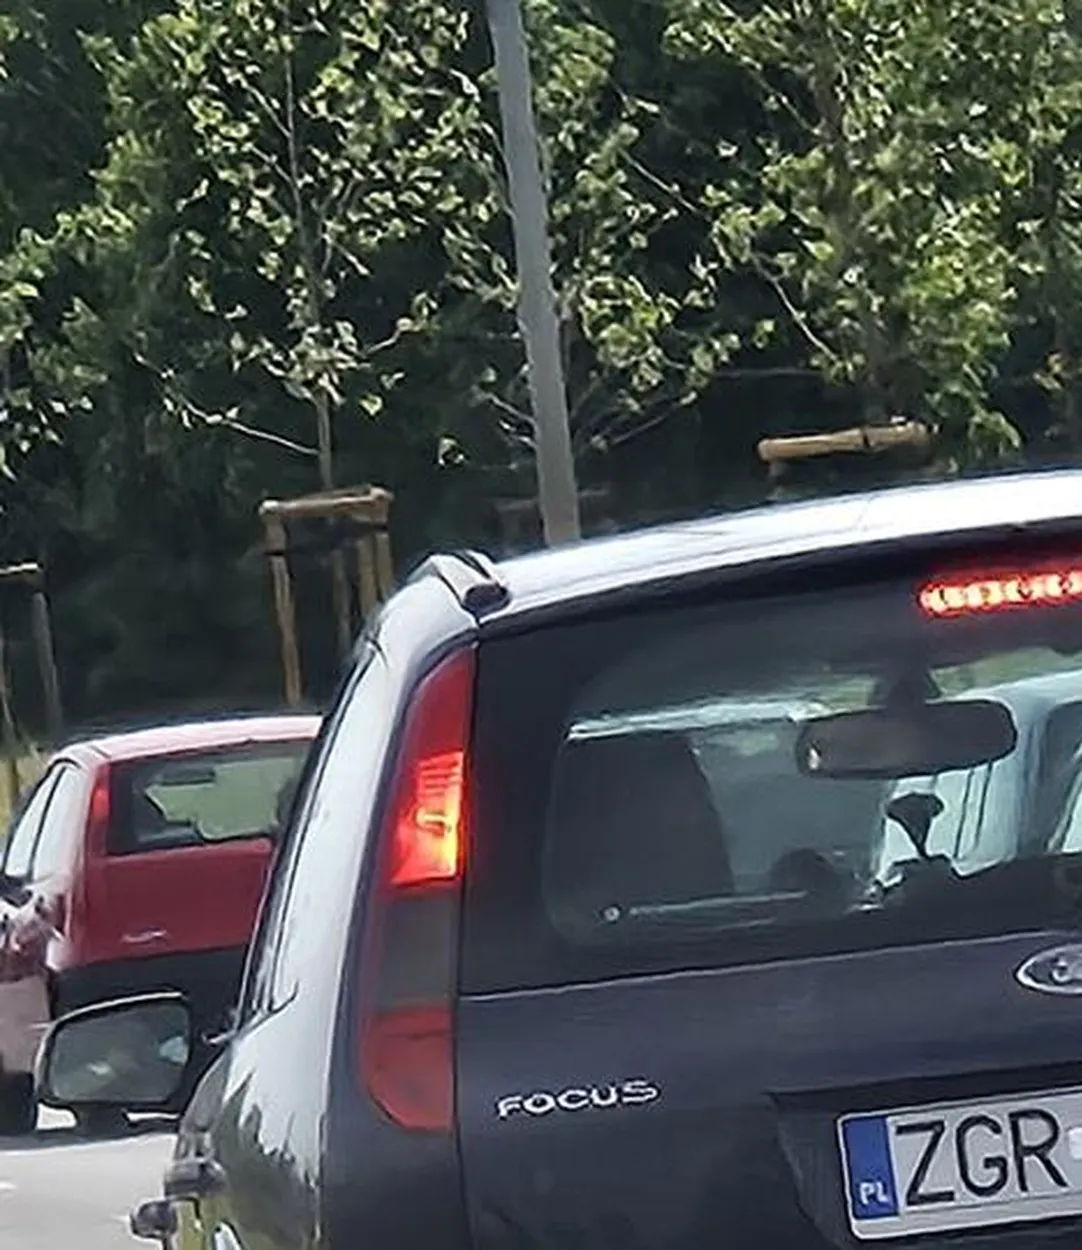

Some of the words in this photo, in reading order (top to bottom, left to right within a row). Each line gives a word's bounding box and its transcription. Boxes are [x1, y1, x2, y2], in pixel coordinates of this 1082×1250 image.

[497, 1079, 659, 1117] FOCUS
[895, 1108, 1067, 1206] ZGR
[860, 1181, 889, 1205] PL
